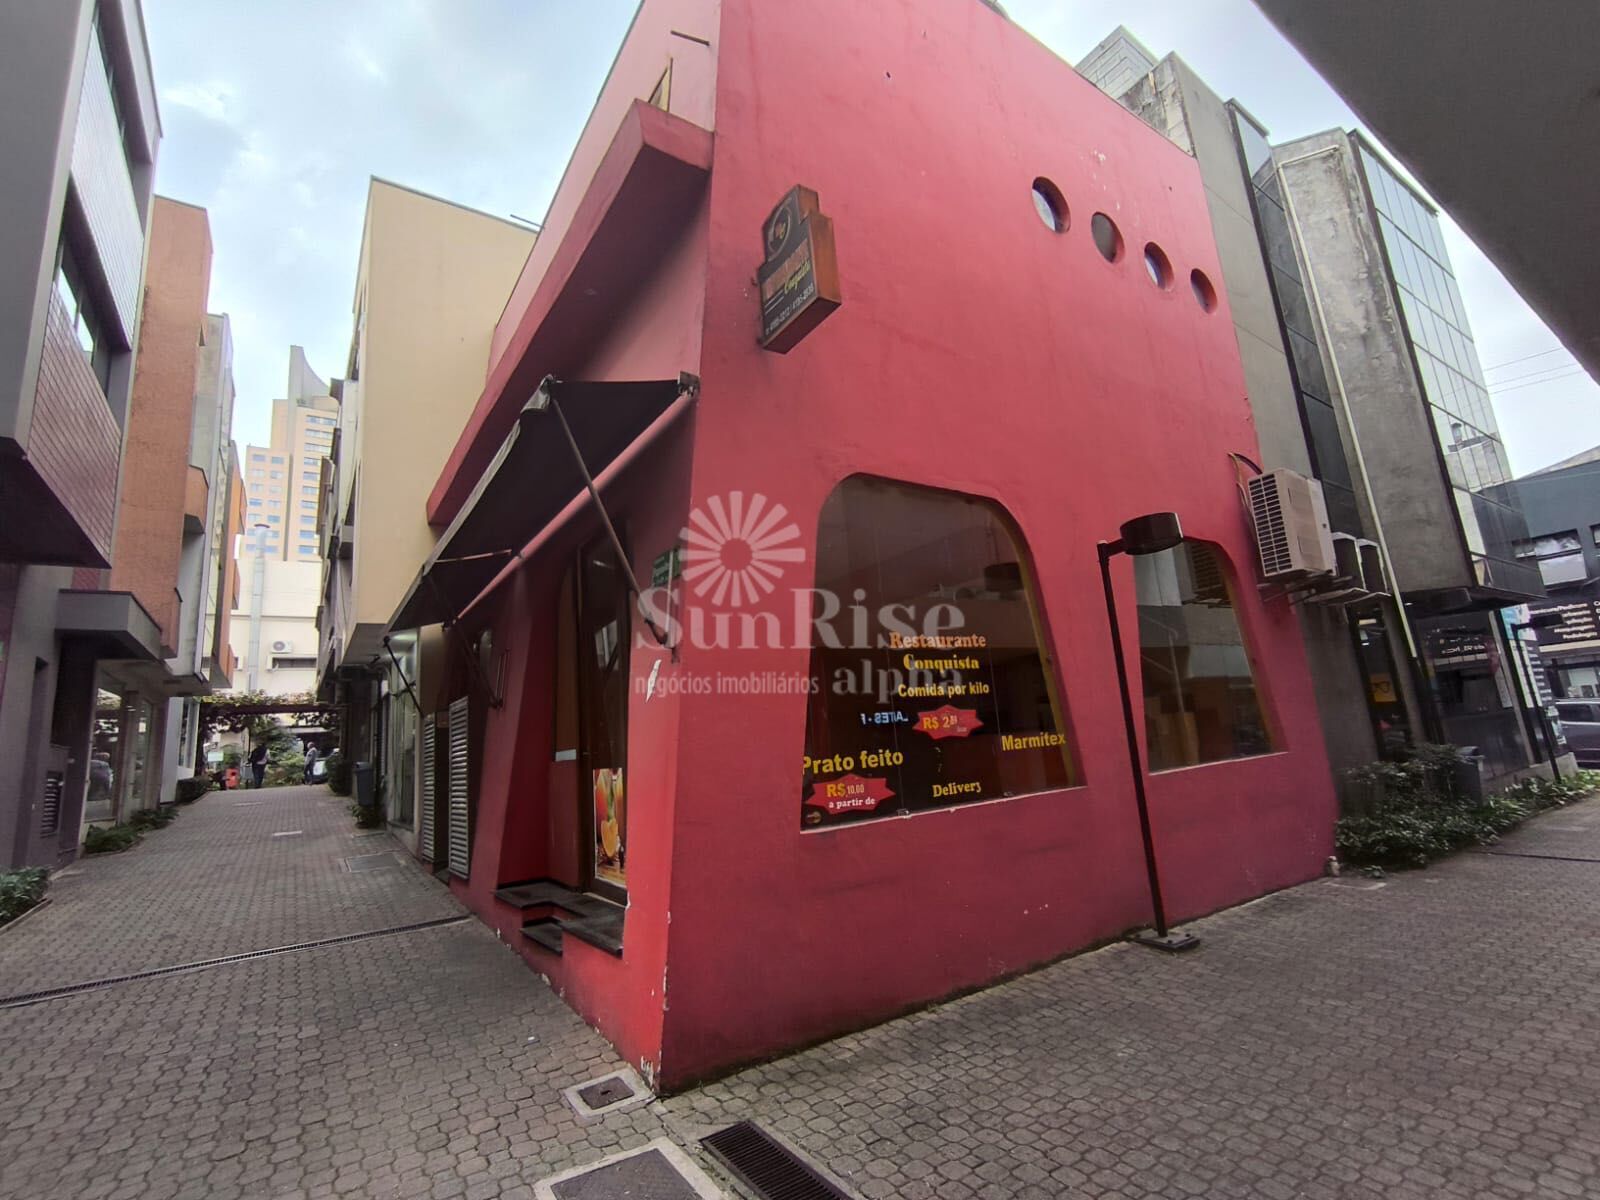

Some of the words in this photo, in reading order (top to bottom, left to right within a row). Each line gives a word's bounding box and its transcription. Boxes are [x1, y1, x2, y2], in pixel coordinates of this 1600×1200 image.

[889, 632, 986, 648] Restaurante
[903, 653, 979, 675] Conquista
[898, 683, 945, 697] Comida
[947, 685, 967, 698] por
[969, 681, 990, 694] kilo
[1001, 731, 1067, 751] Marmitex
[802, 754, 855, 775] Prato
[860, 749, 904, 769] feito
[932, 781, 982, 798] Delivery
[828, 801, 836, 809] a
[836, 797, 864, 810] partir
[865, 796, 876, 806] de
